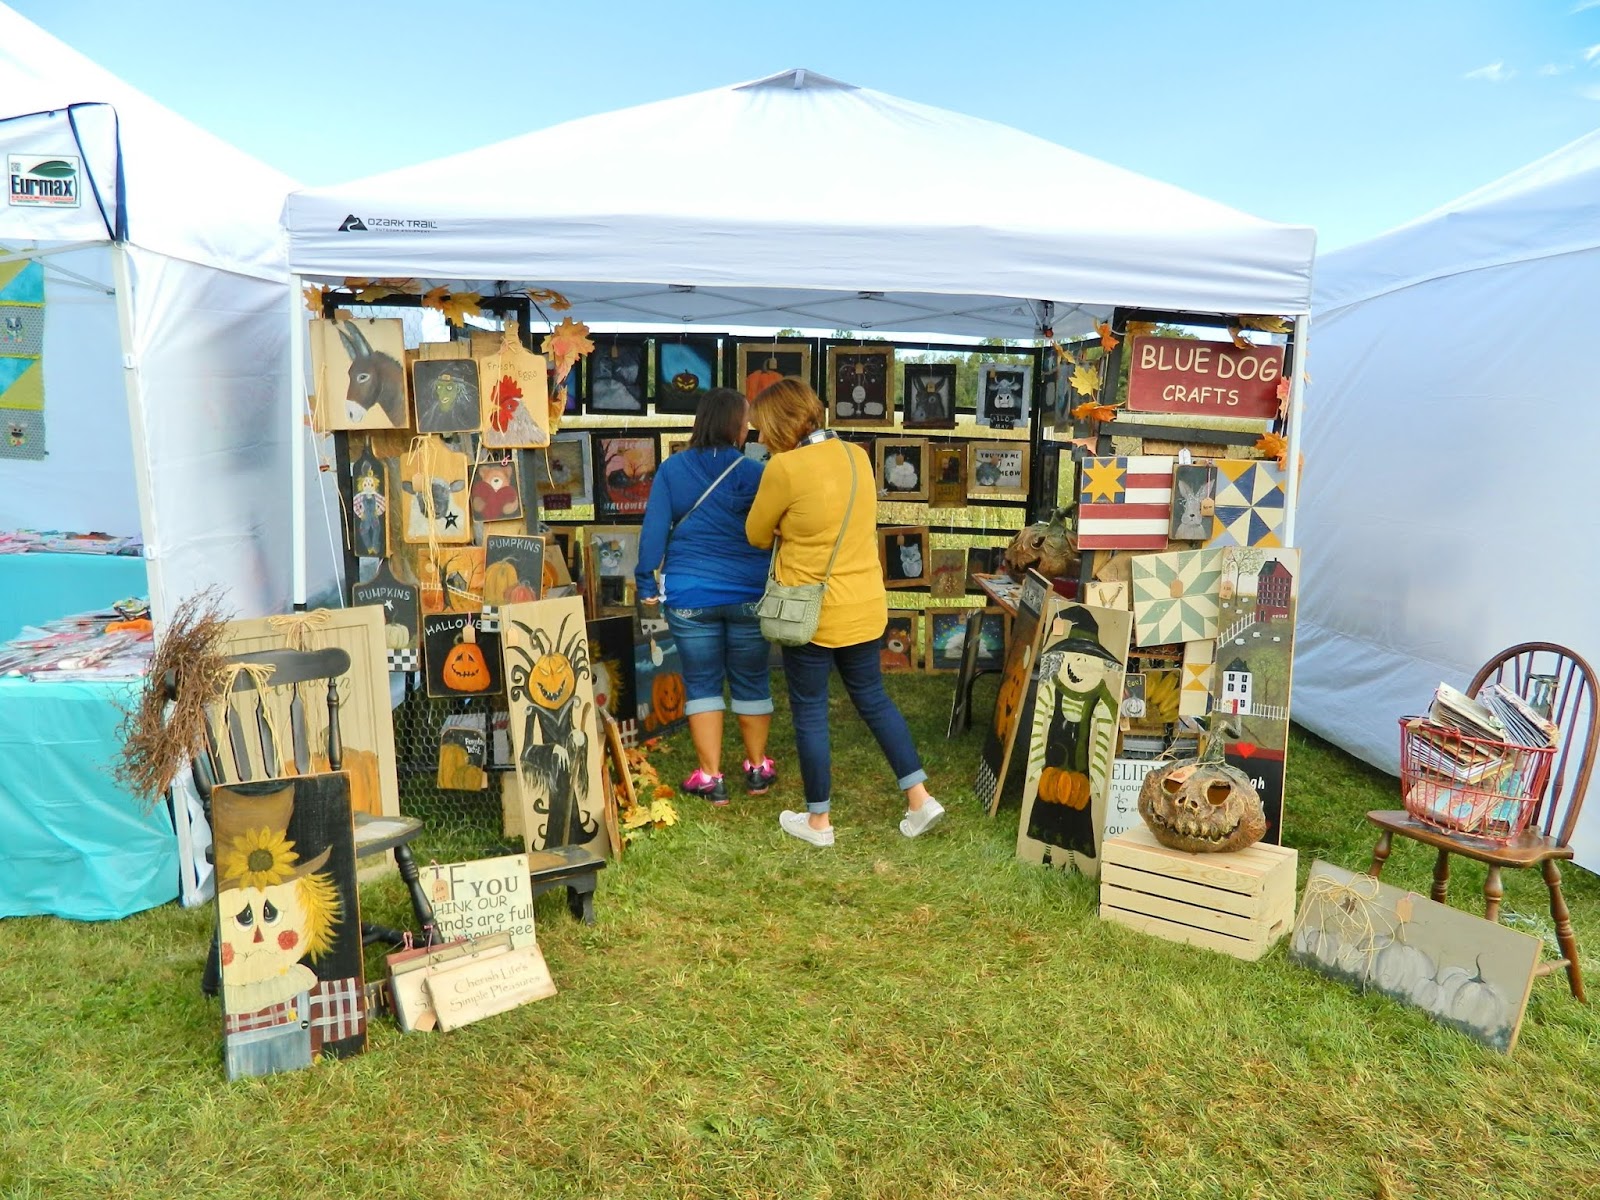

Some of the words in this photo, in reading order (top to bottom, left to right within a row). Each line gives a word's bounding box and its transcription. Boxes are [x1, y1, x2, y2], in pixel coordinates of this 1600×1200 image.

[11, 174, 73, 197] Eurmax
[368, 218, 405, 228] OZARK
[407, 220, 437, 229] TRAIL
[1141, 344, 1211, 374] BLUE
[1217, 353, 1278, 382] DOG
[517, 370, 537, 381] Eggs
[1162, 384, 1239, 406] CRAFTS
[604, 502, 647, 511] HALLOWEE
[489, 538, 541, 553] PUMPKINS
[358, 587, 411, 601] PUMPKINS
[425, 618, 482, 636] HALLOWE
[470, 876, 518, 898] YOU
[434, 900, 473, 916] HINK
[478, 895, 508, 910] OUR
[437, 914, 473, 931] ands
[478, 913, 505, 927] are
[509, 904, 533, 922] full
[509, 924, 533, 936] see
[454, 970, 500, 994] Cherish
[500, 962, 529, 980] Life's
[450, 990, 489, 1012] Simple
[490, 976, 540, 998] Pleasures
